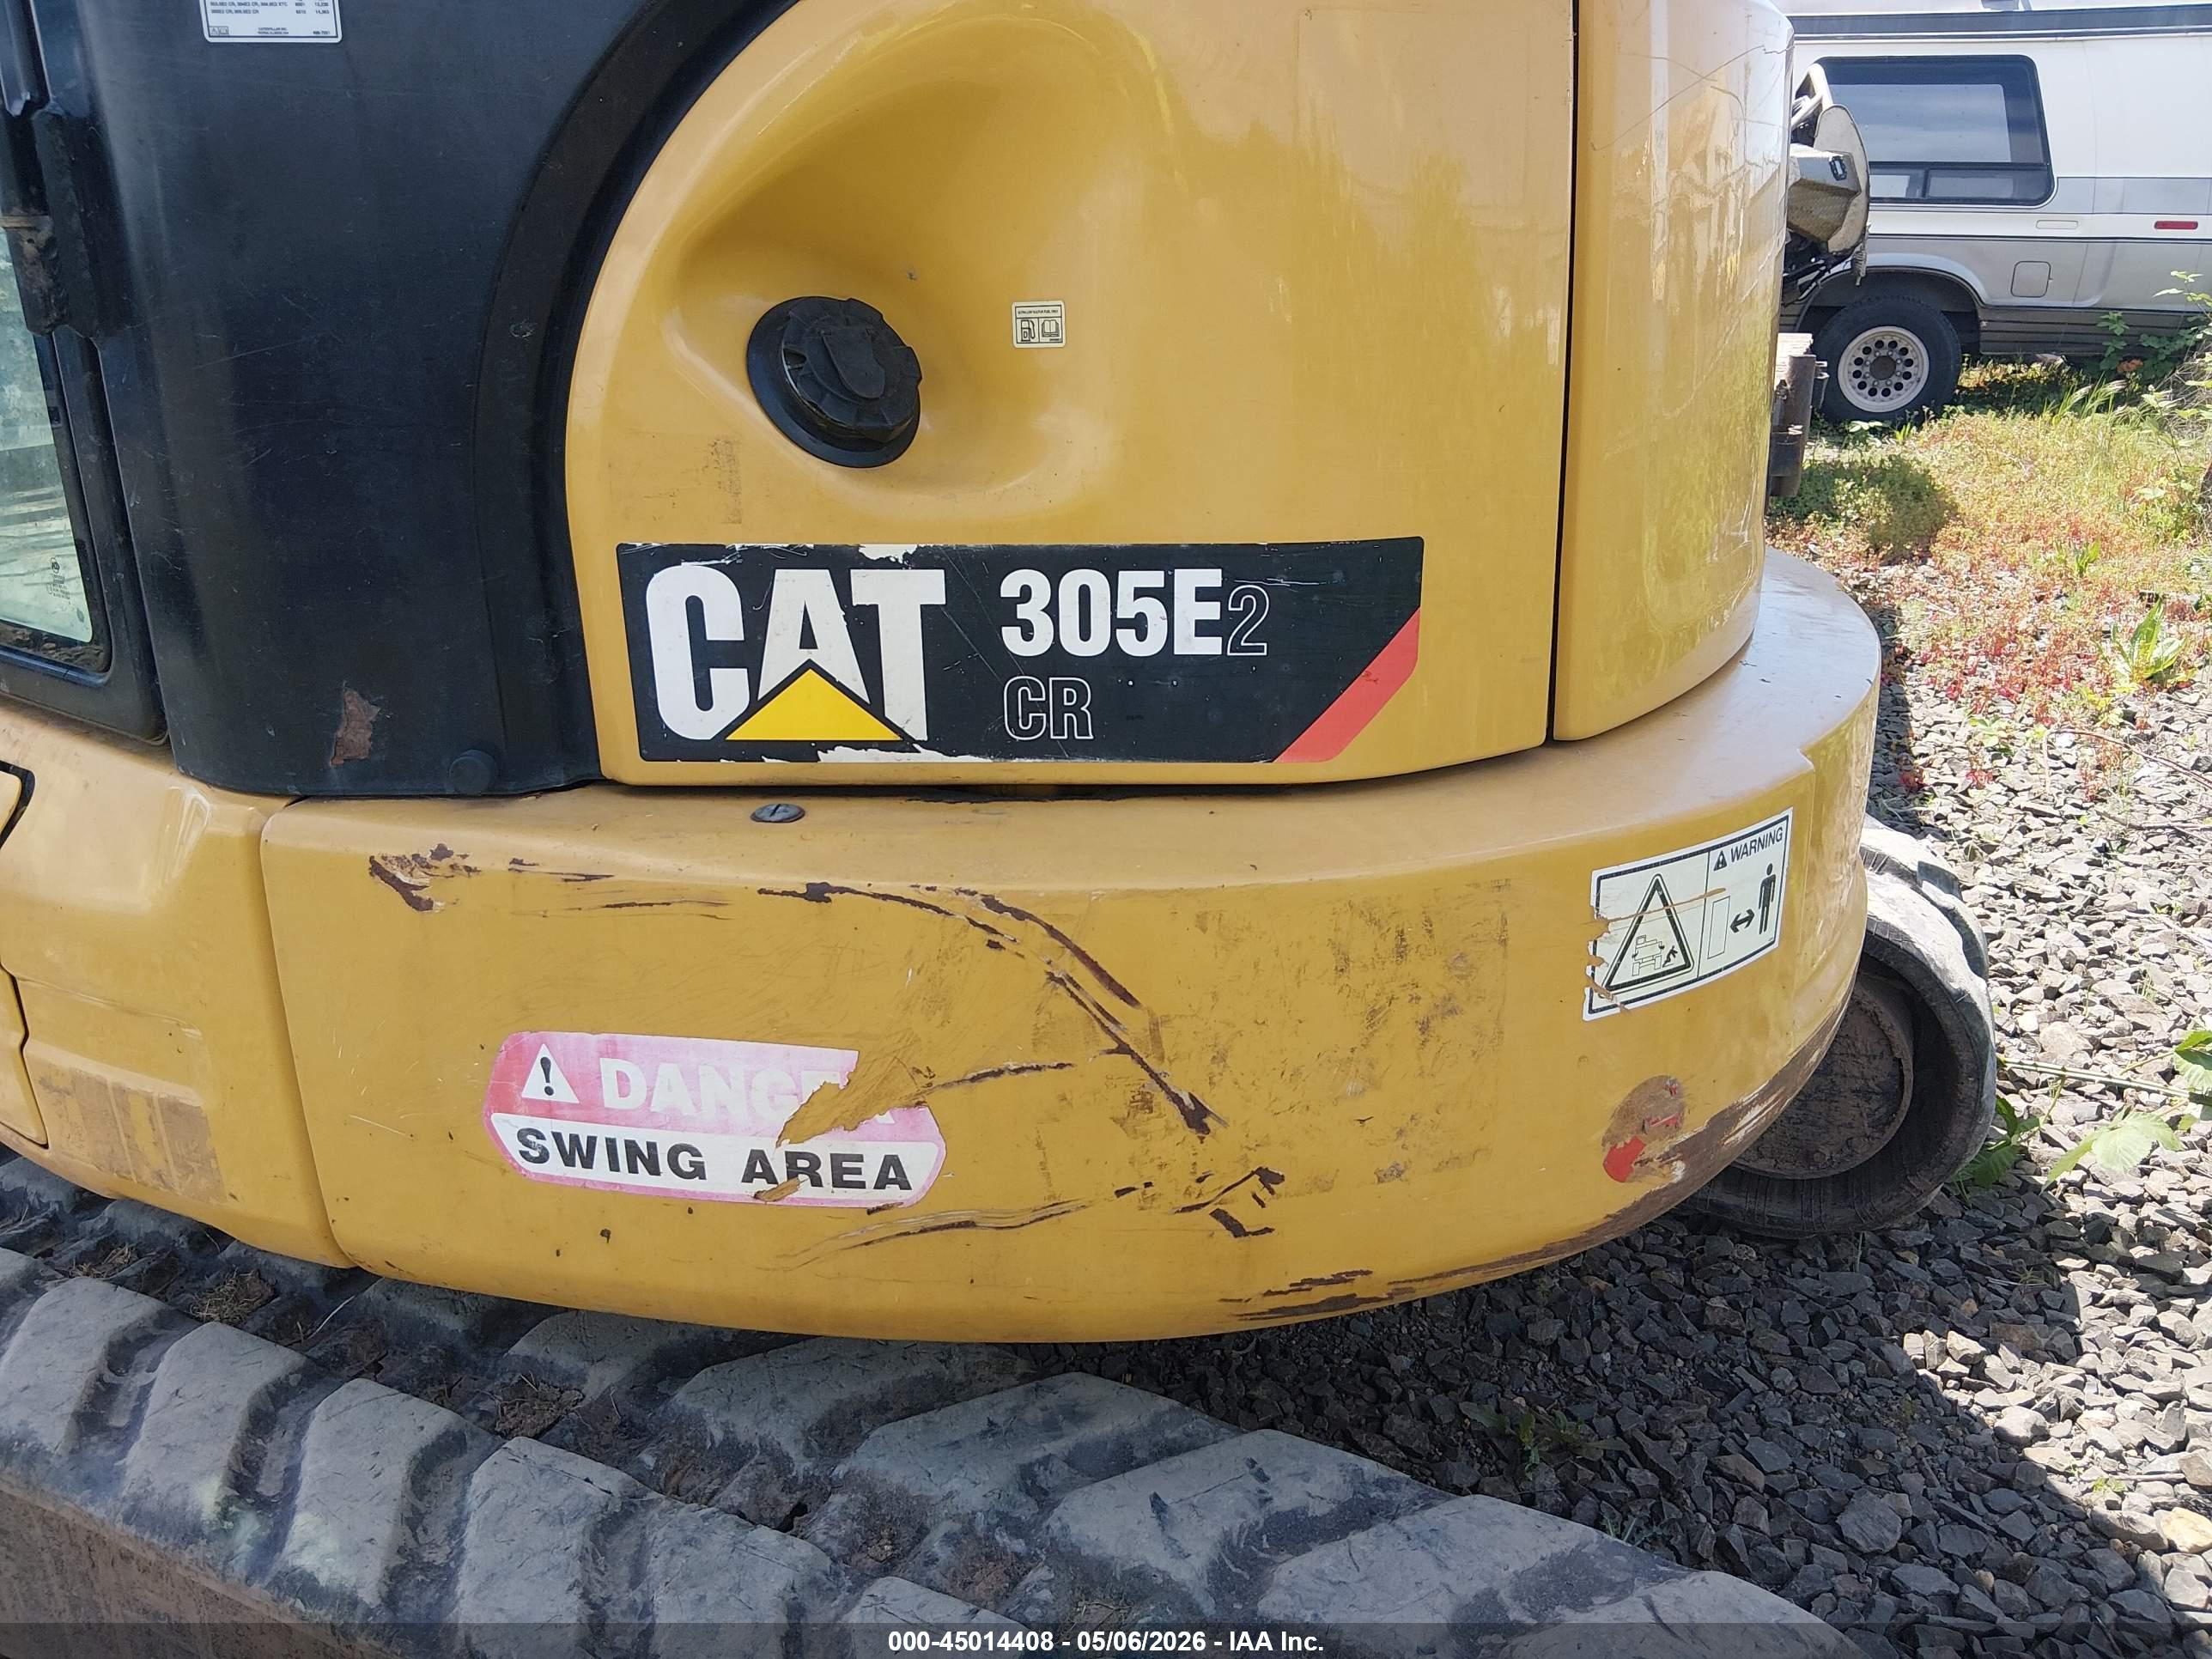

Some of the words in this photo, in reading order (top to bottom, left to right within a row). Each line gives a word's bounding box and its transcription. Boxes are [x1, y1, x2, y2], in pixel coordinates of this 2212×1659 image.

[646, 565, 945, 741] CAT
[1000, 568, 1269, 657] 305E2
[1004, 676, 1094, 740] CR
[1730, 826, 1784, 863] WARNING
[600, 1057, 895, 1124] DANG
[516, 1127, 708, 1181] SWING
[741, 1148, 913, 1190] AREA
